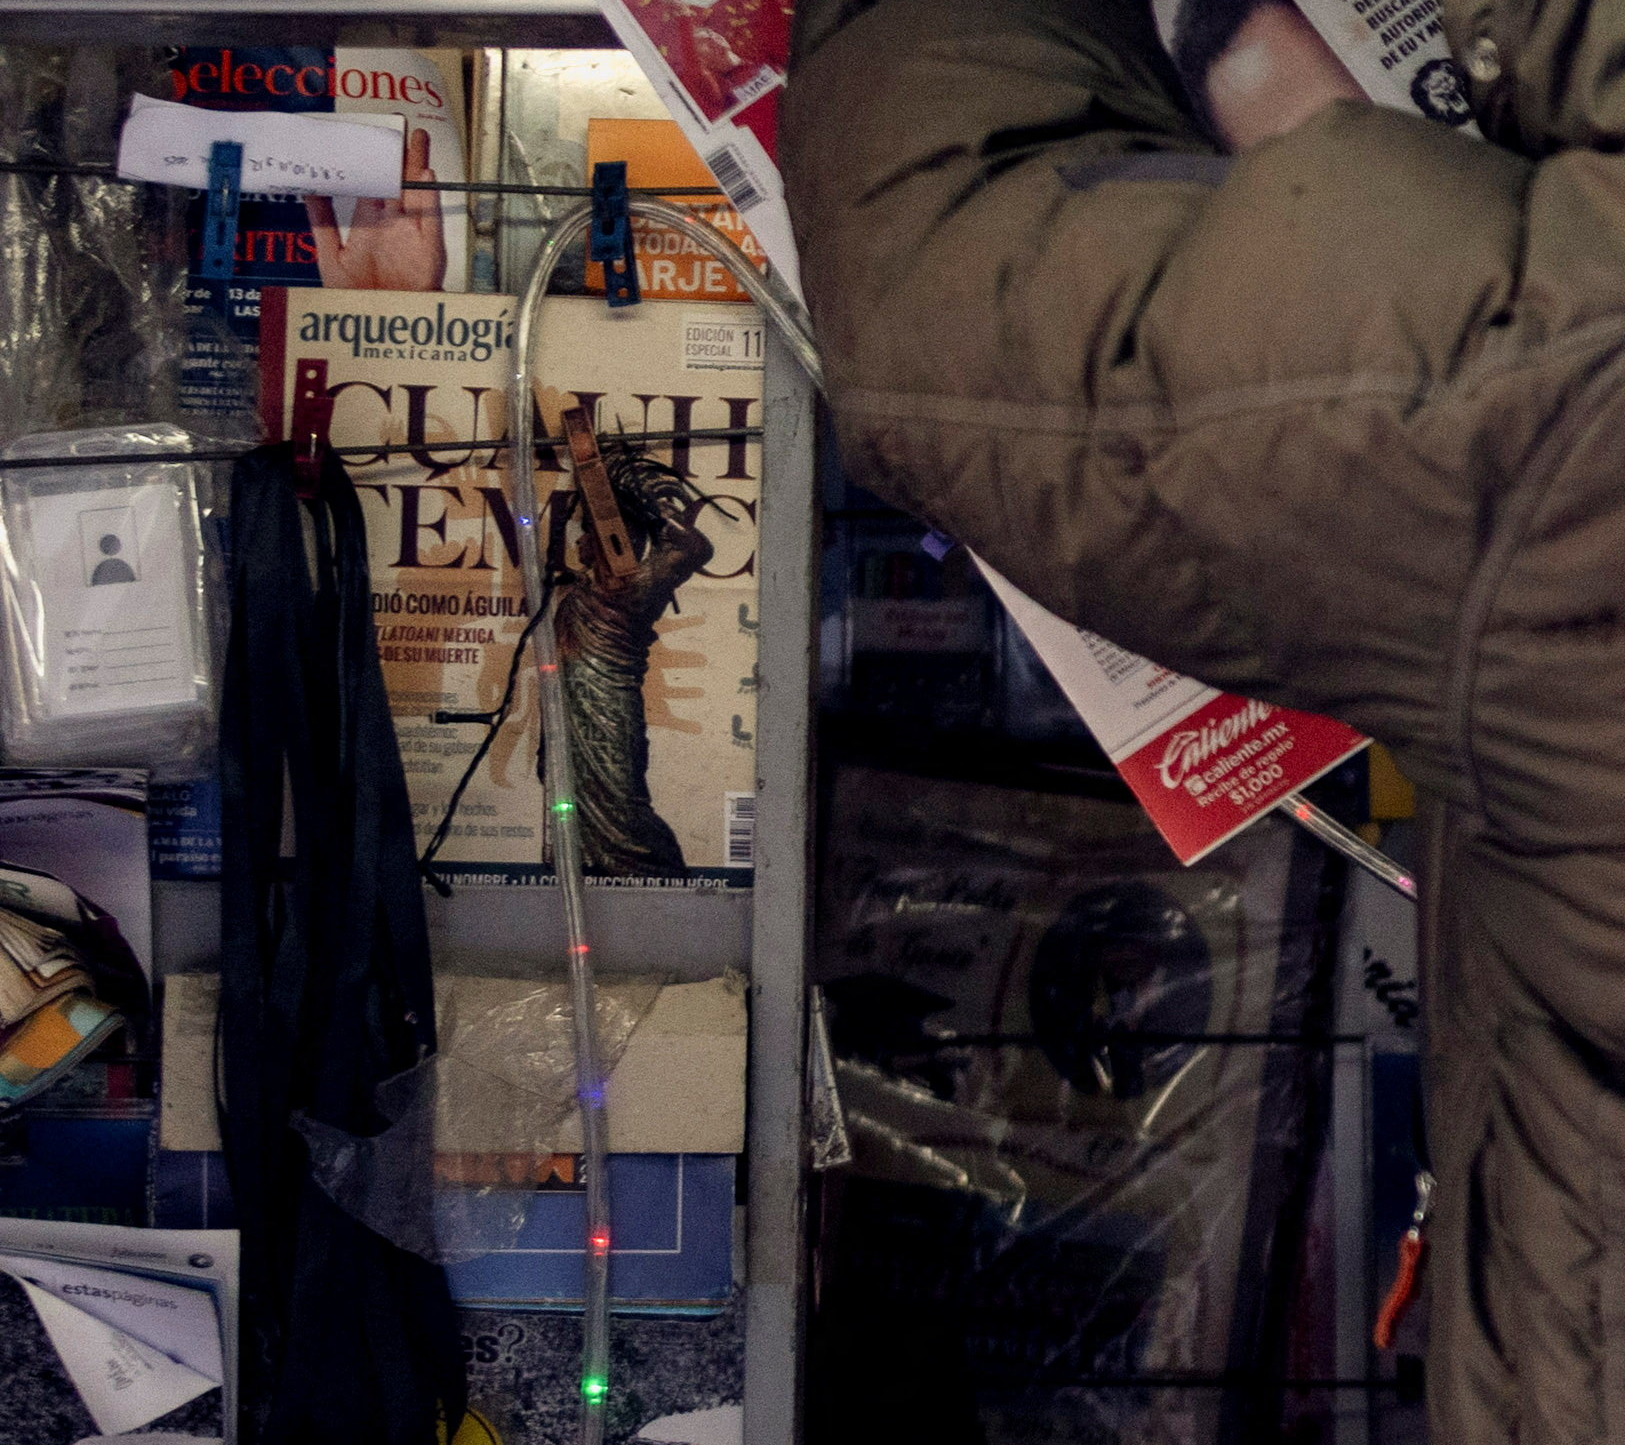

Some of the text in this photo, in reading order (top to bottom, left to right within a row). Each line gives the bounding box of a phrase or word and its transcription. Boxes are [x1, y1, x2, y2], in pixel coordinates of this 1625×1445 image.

[301, 303, 516, 363] arqueología
[363, 347, 469, 361] mexicana
[407, 591, 529, 617] COMO ÁGUILA
[444, 628, 495, 643] MEXICA
[422, 648, 479, 664] MUERTE
[1203, 723, 1288, 783] caliente.mx
